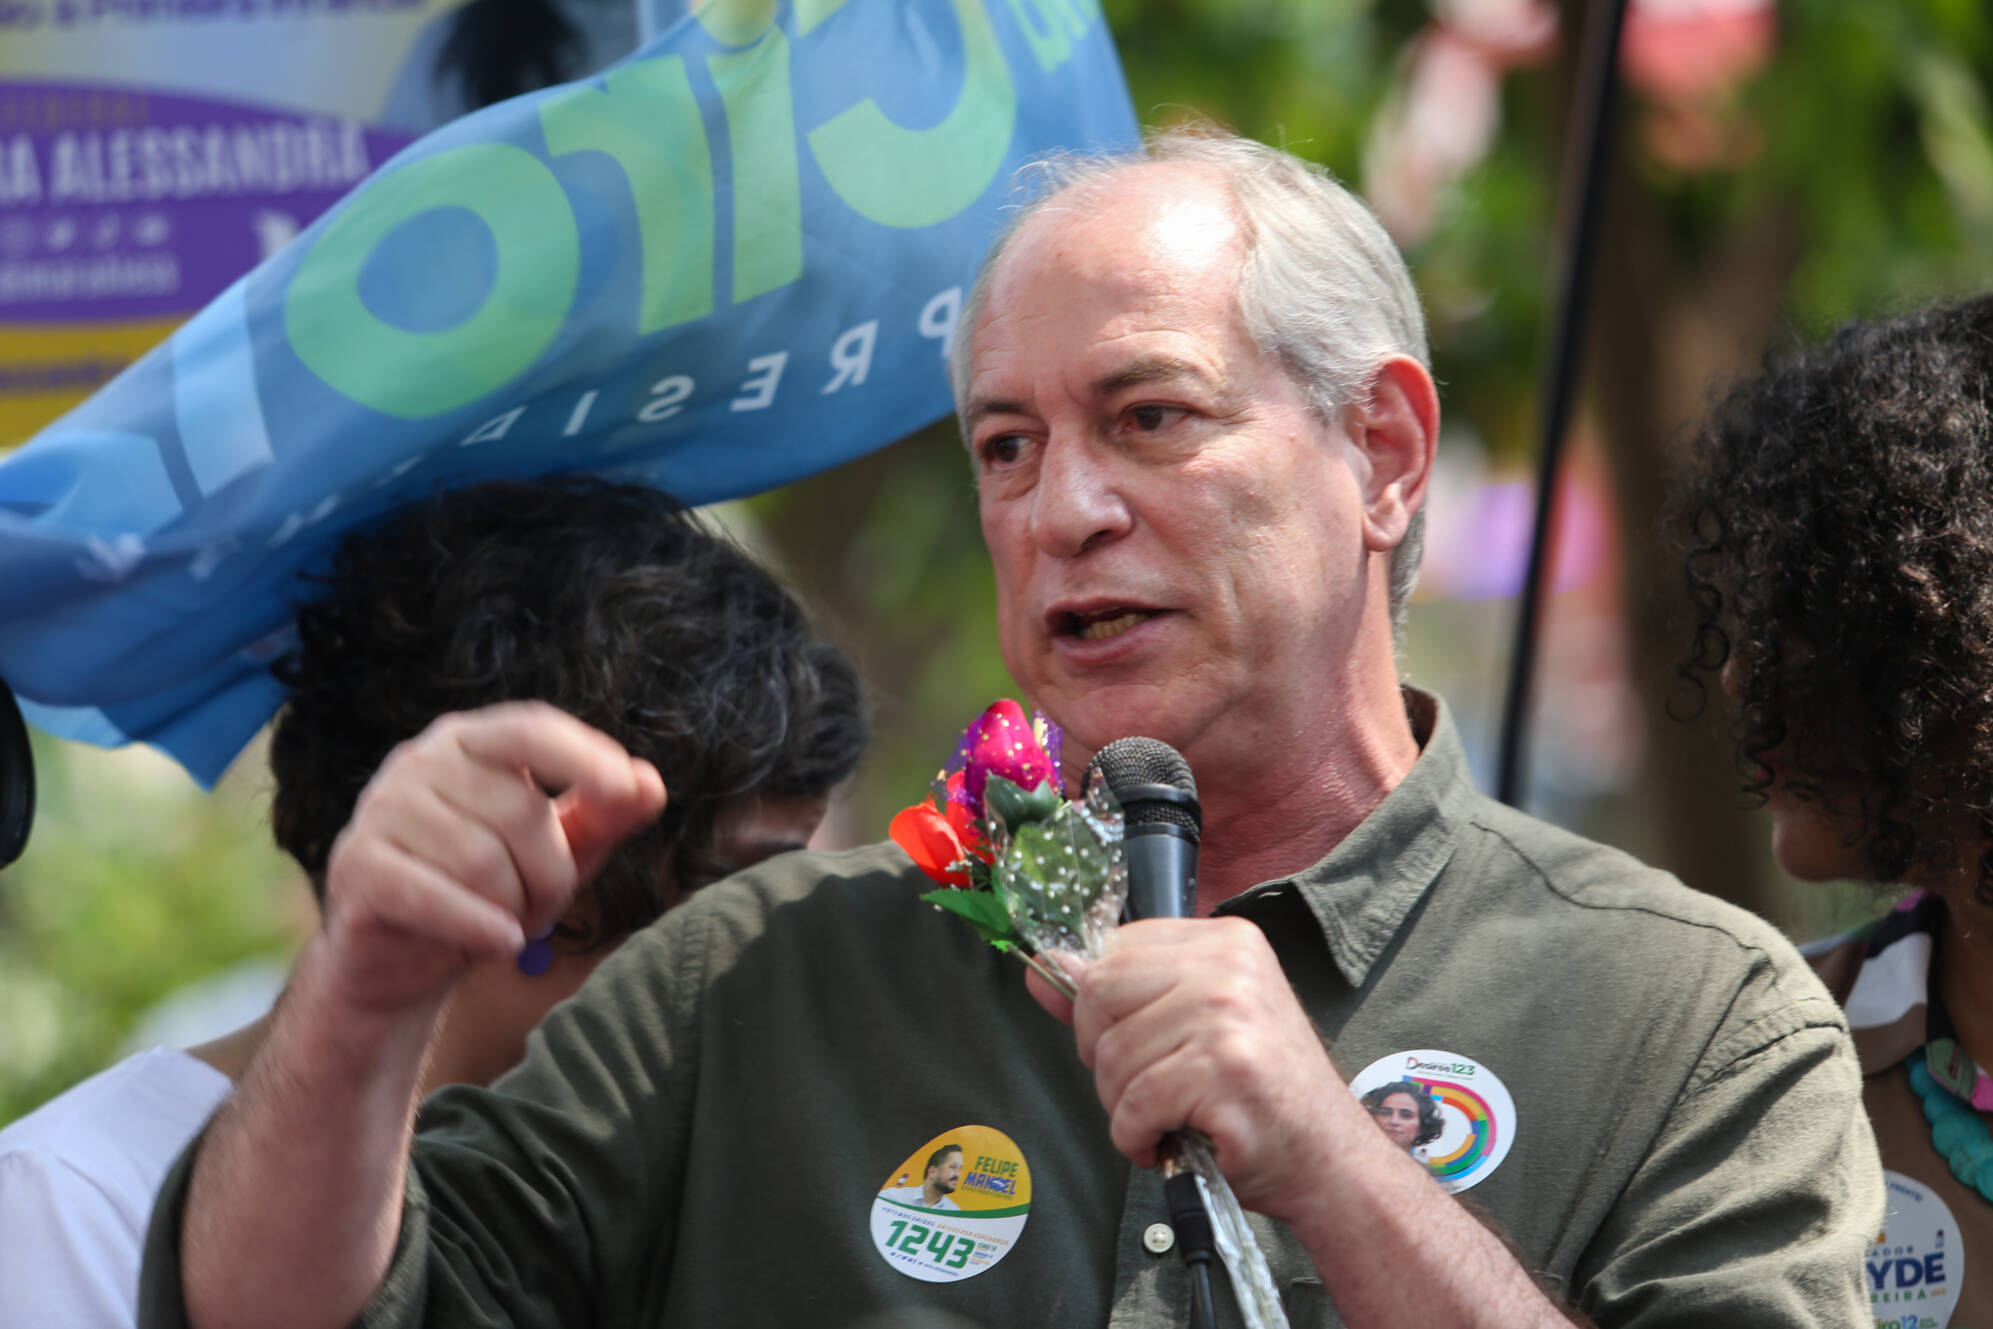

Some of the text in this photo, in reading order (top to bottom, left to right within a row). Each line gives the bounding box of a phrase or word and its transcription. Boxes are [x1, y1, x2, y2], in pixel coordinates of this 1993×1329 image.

[50, 117, 372, 203] ALESSANDRA
[974, 1155, 1020, 1178] FELIPE
[885, 1220, 976, 1270] 1243
